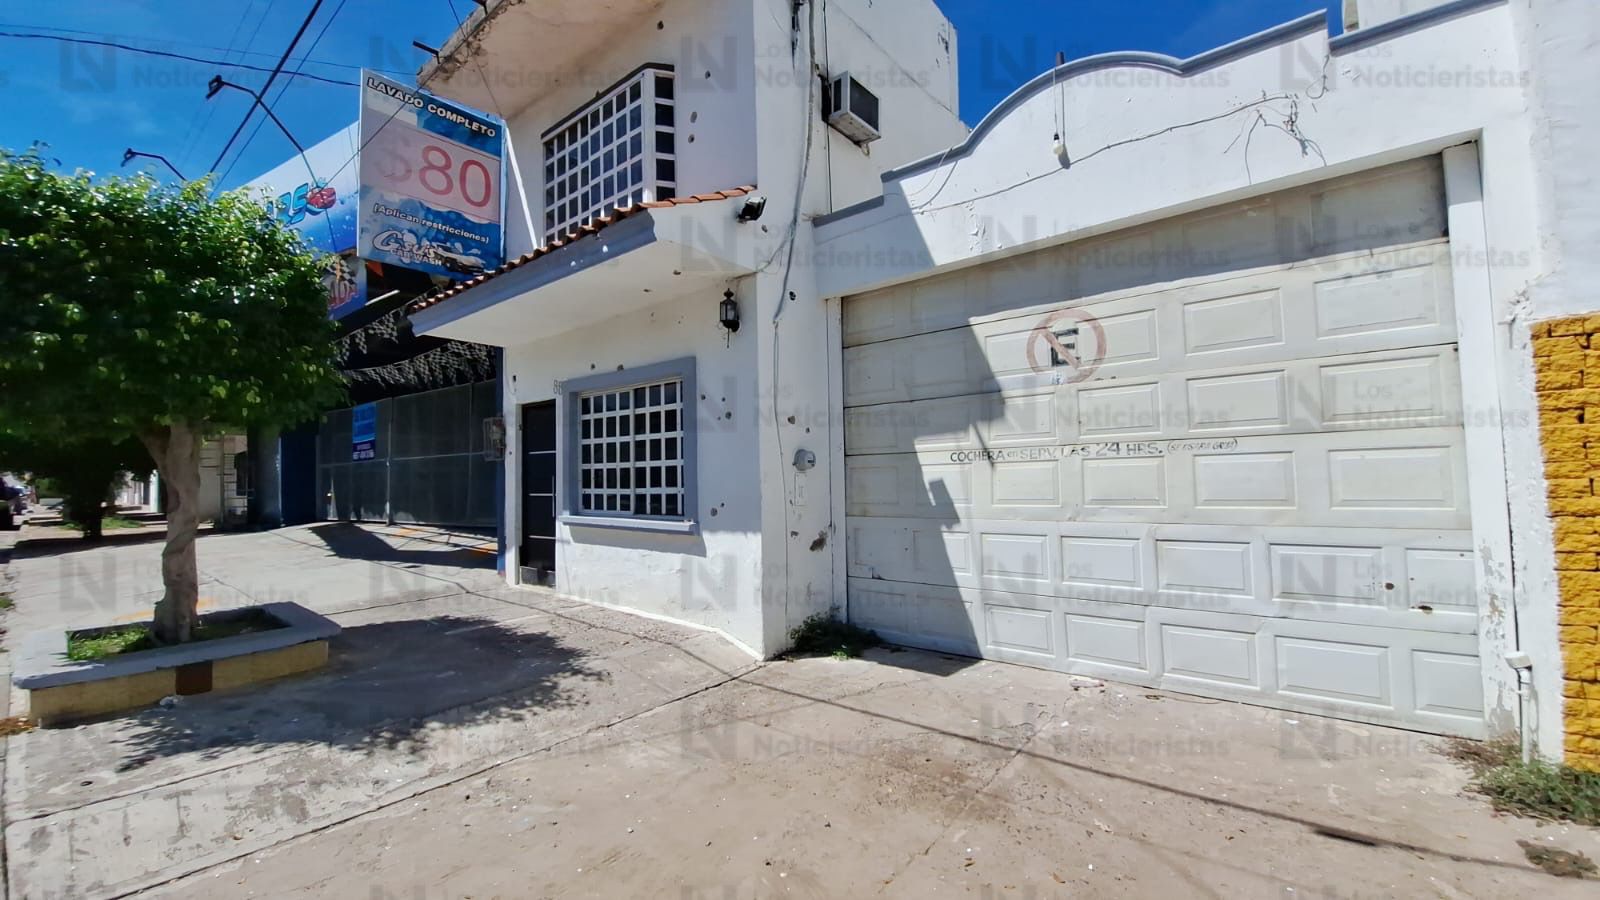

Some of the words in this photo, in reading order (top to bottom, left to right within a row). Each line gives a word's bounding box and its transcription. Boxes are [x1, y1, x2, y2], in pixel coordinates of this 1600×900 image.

[367, 77, 424, 108] LAVADO
[427, 103, 497, 137] COMPLETO
[373, 203, 422, 225] (Aplican
[421, 217, 490, 244] restricciones)
[950, 450, 1006, 463] COCHERA
[1095, 441, 1121, 457] 24
[1126, 442, 1164, 456] HRS.
